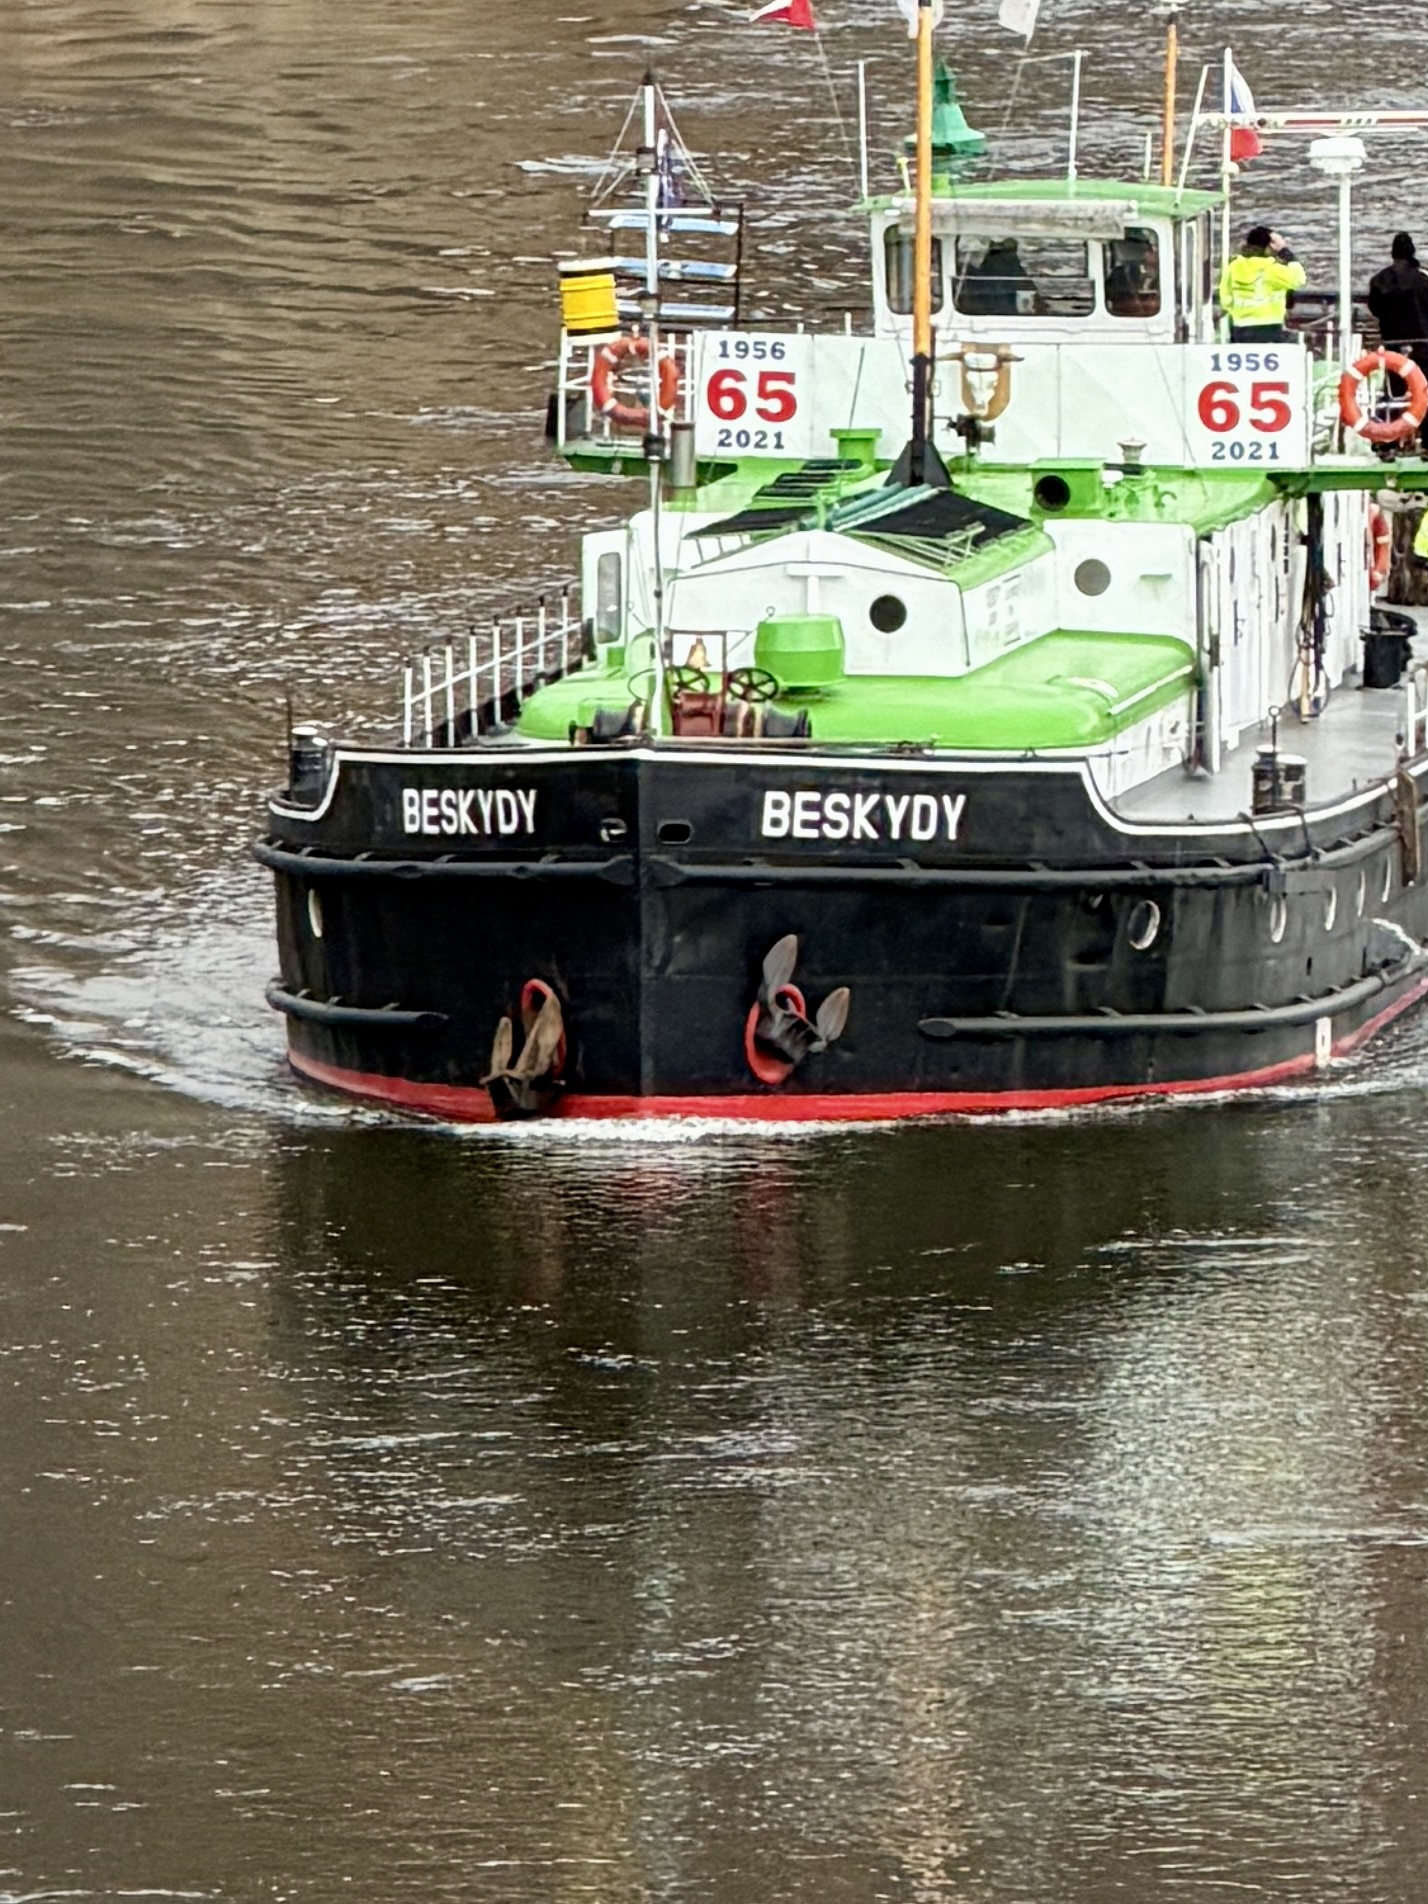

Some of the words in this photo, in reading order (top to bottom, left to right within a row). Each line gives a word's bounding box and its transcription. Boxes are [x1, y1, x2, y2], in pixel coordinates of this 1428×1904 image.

[718, 340, 786, 360] 1956
[1210, 353, 1280, 372] 1956
[707, 368, 798, 423] 65
[1198, 381, 1292, 433] 65
[717, 428, 785, 450] 2021
[1211, 441, 1280, 461] 2021
[402, 787, 537, 835] BESKYDY
[761, 790, 966, 841] BESKYDY
